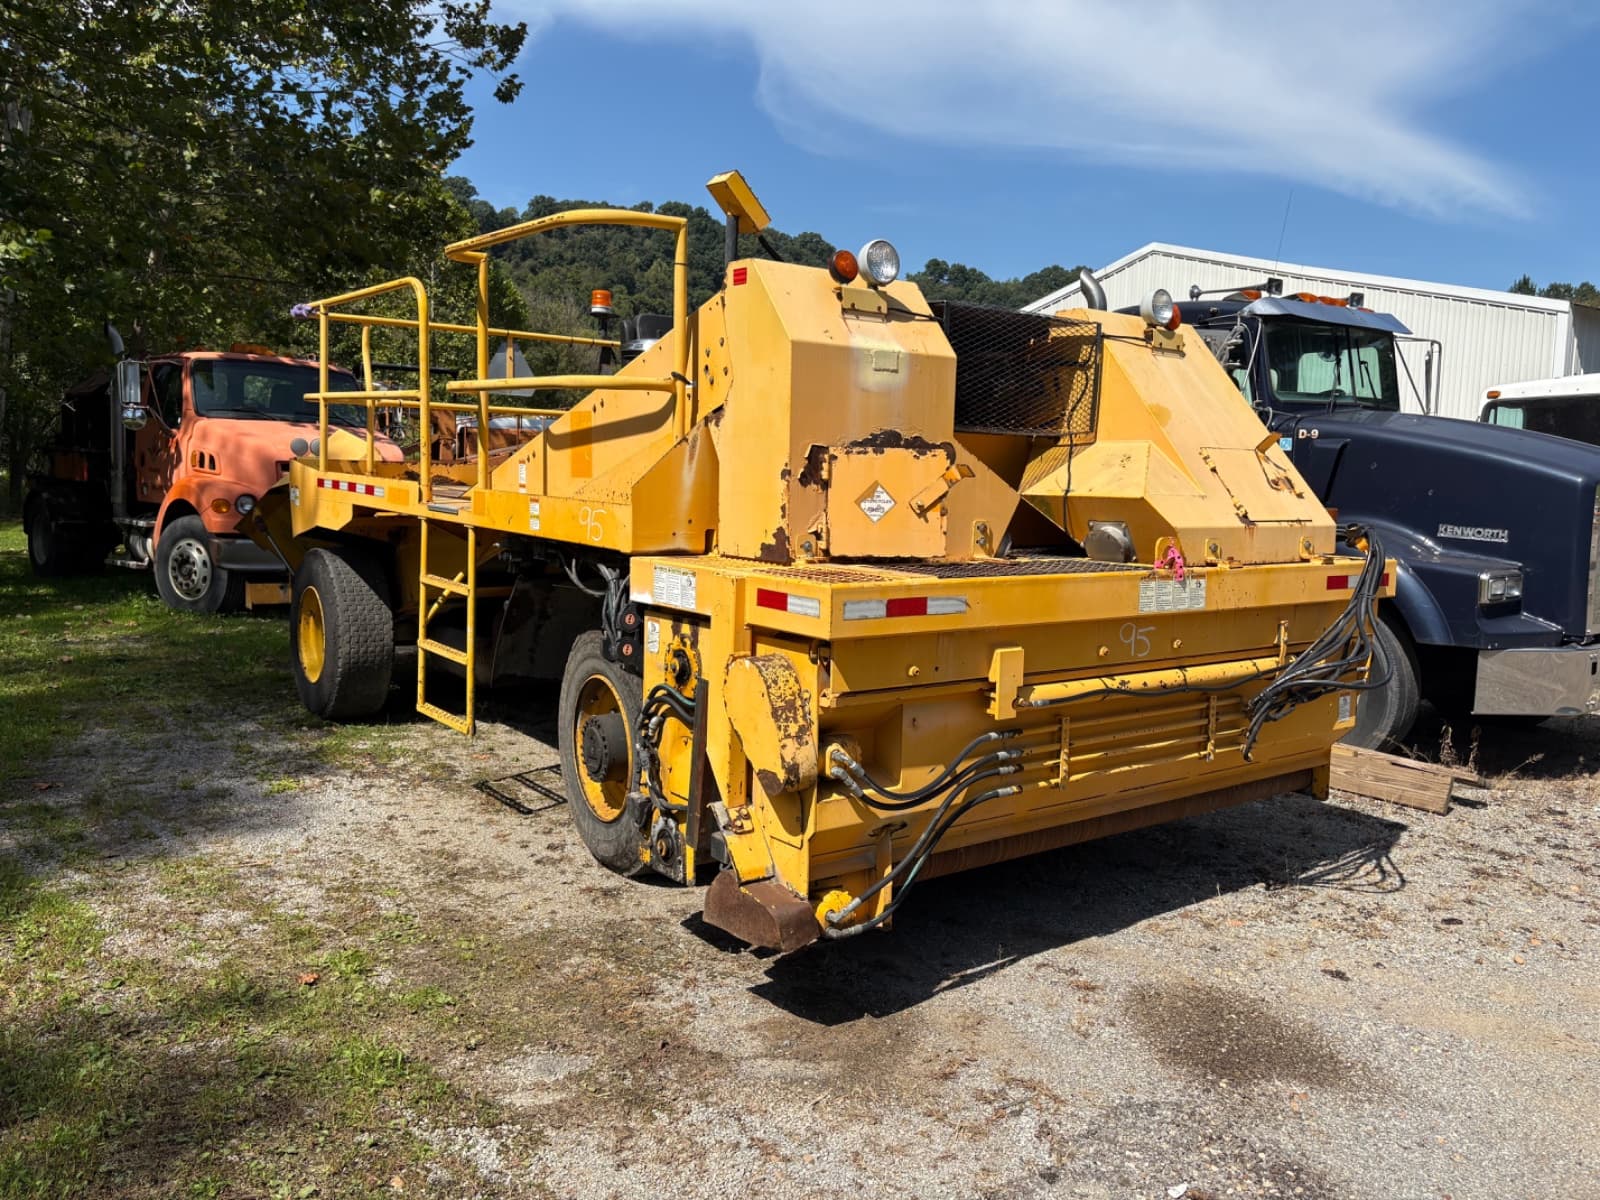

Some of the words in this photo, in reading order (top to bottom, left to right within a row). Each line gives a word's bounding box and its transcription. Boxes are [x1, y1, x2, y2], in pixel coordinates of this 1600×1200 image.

[1298, 429, 1319, 439] D-9
[579, 506, 607, 541] 95
[1437, 523, 1509, 542] KENWORTH
[1120, 623, 1157, 656] 95
